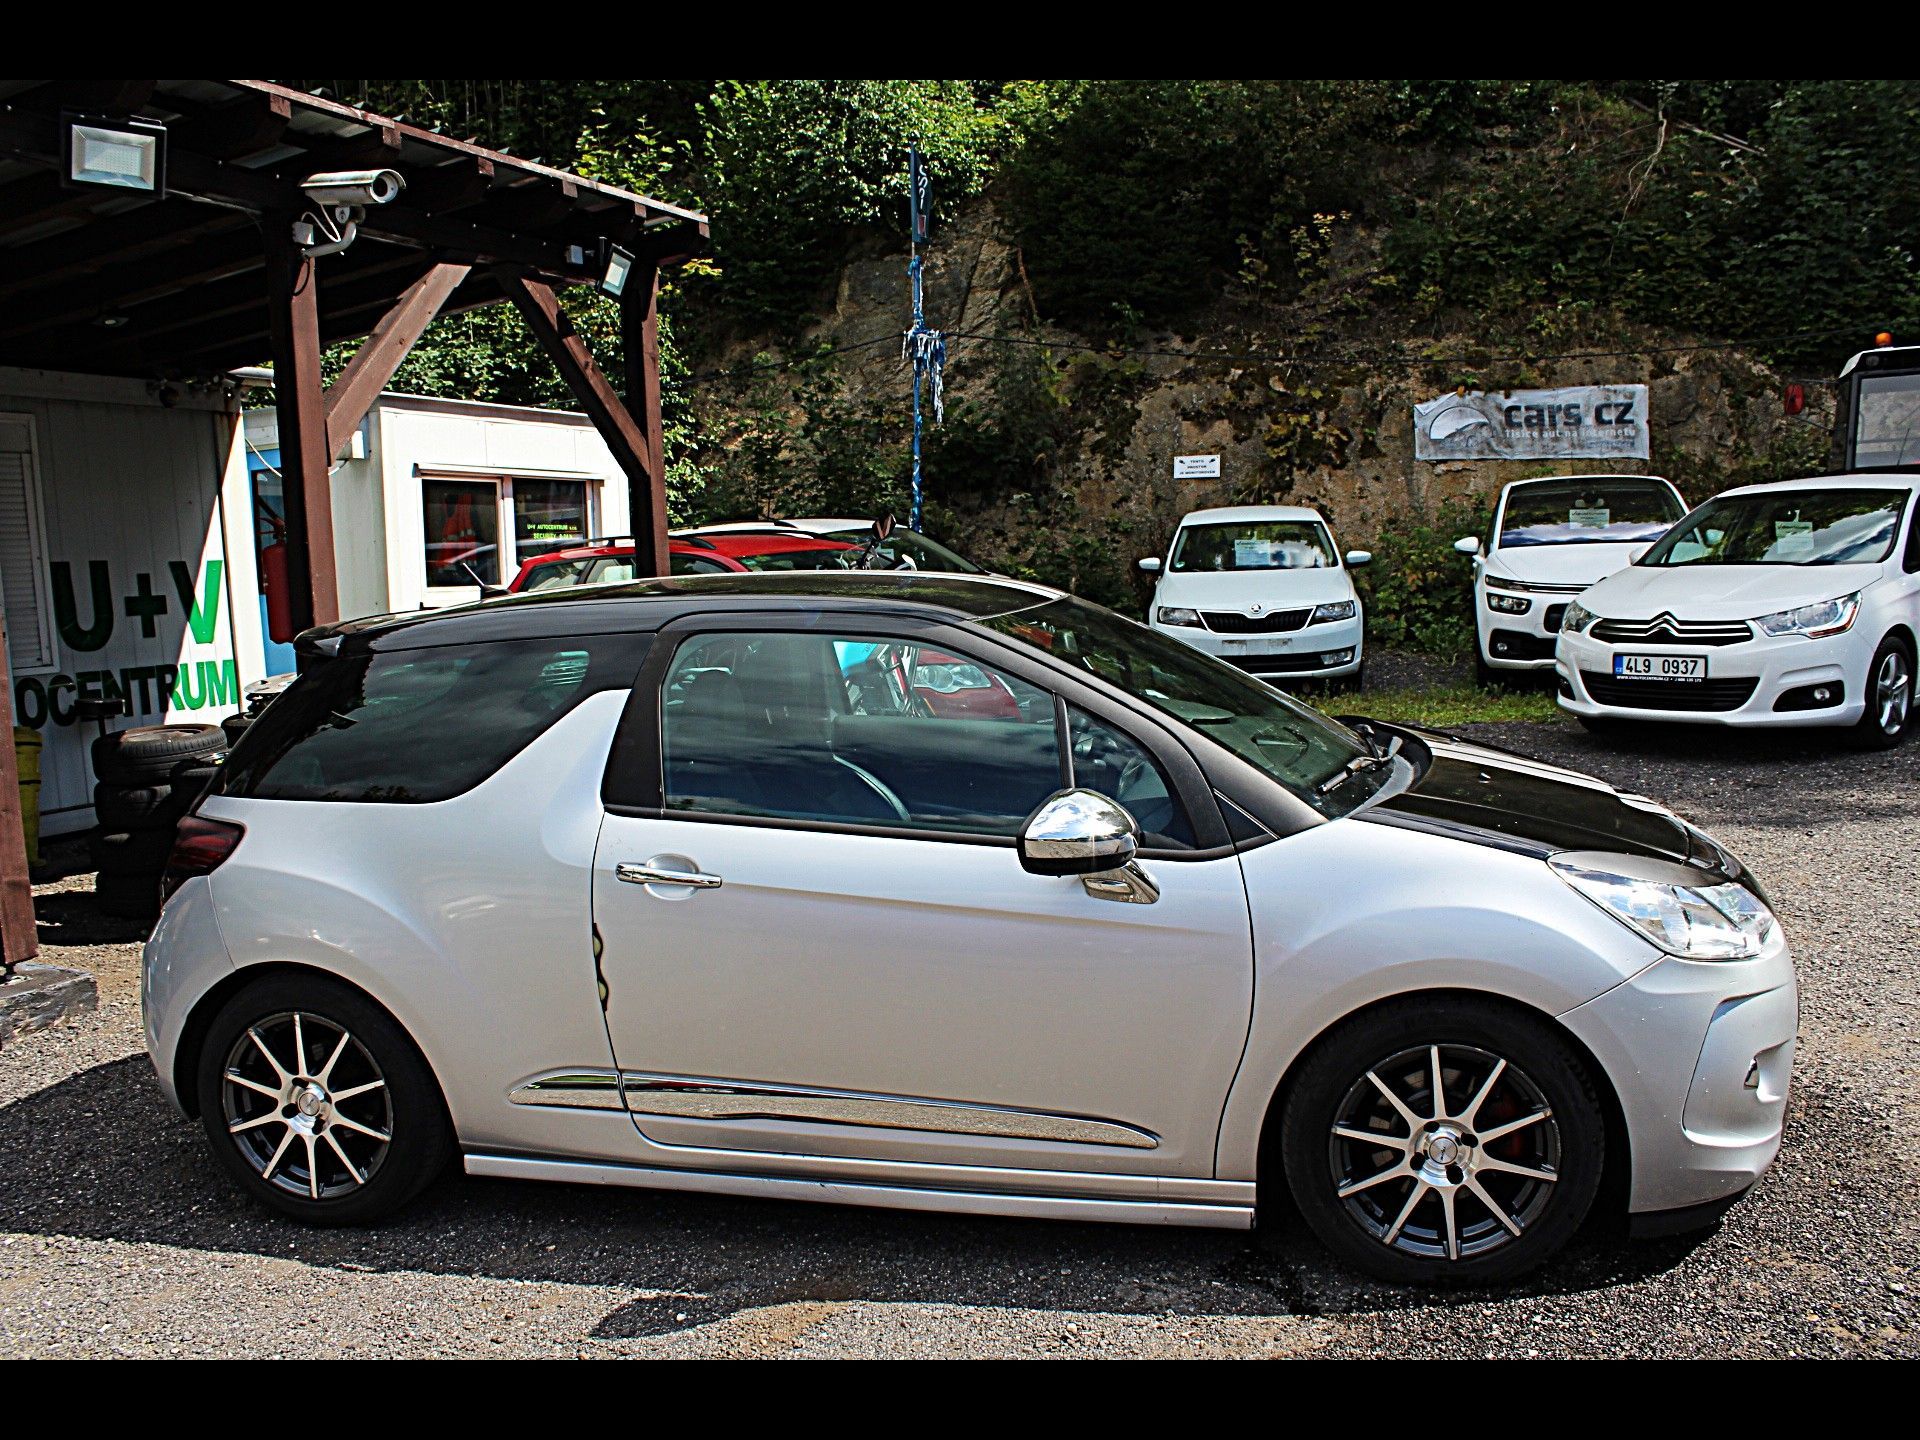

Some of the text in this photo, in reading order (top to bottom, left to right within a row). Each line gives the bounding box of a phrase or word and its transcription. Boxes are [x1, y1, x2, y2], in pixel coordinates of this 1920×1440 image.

[50, 560, 223, 652] U+V
[1626, 658, 1651, 673] 4L9
[1662, 659, 1698, 675] 0937
